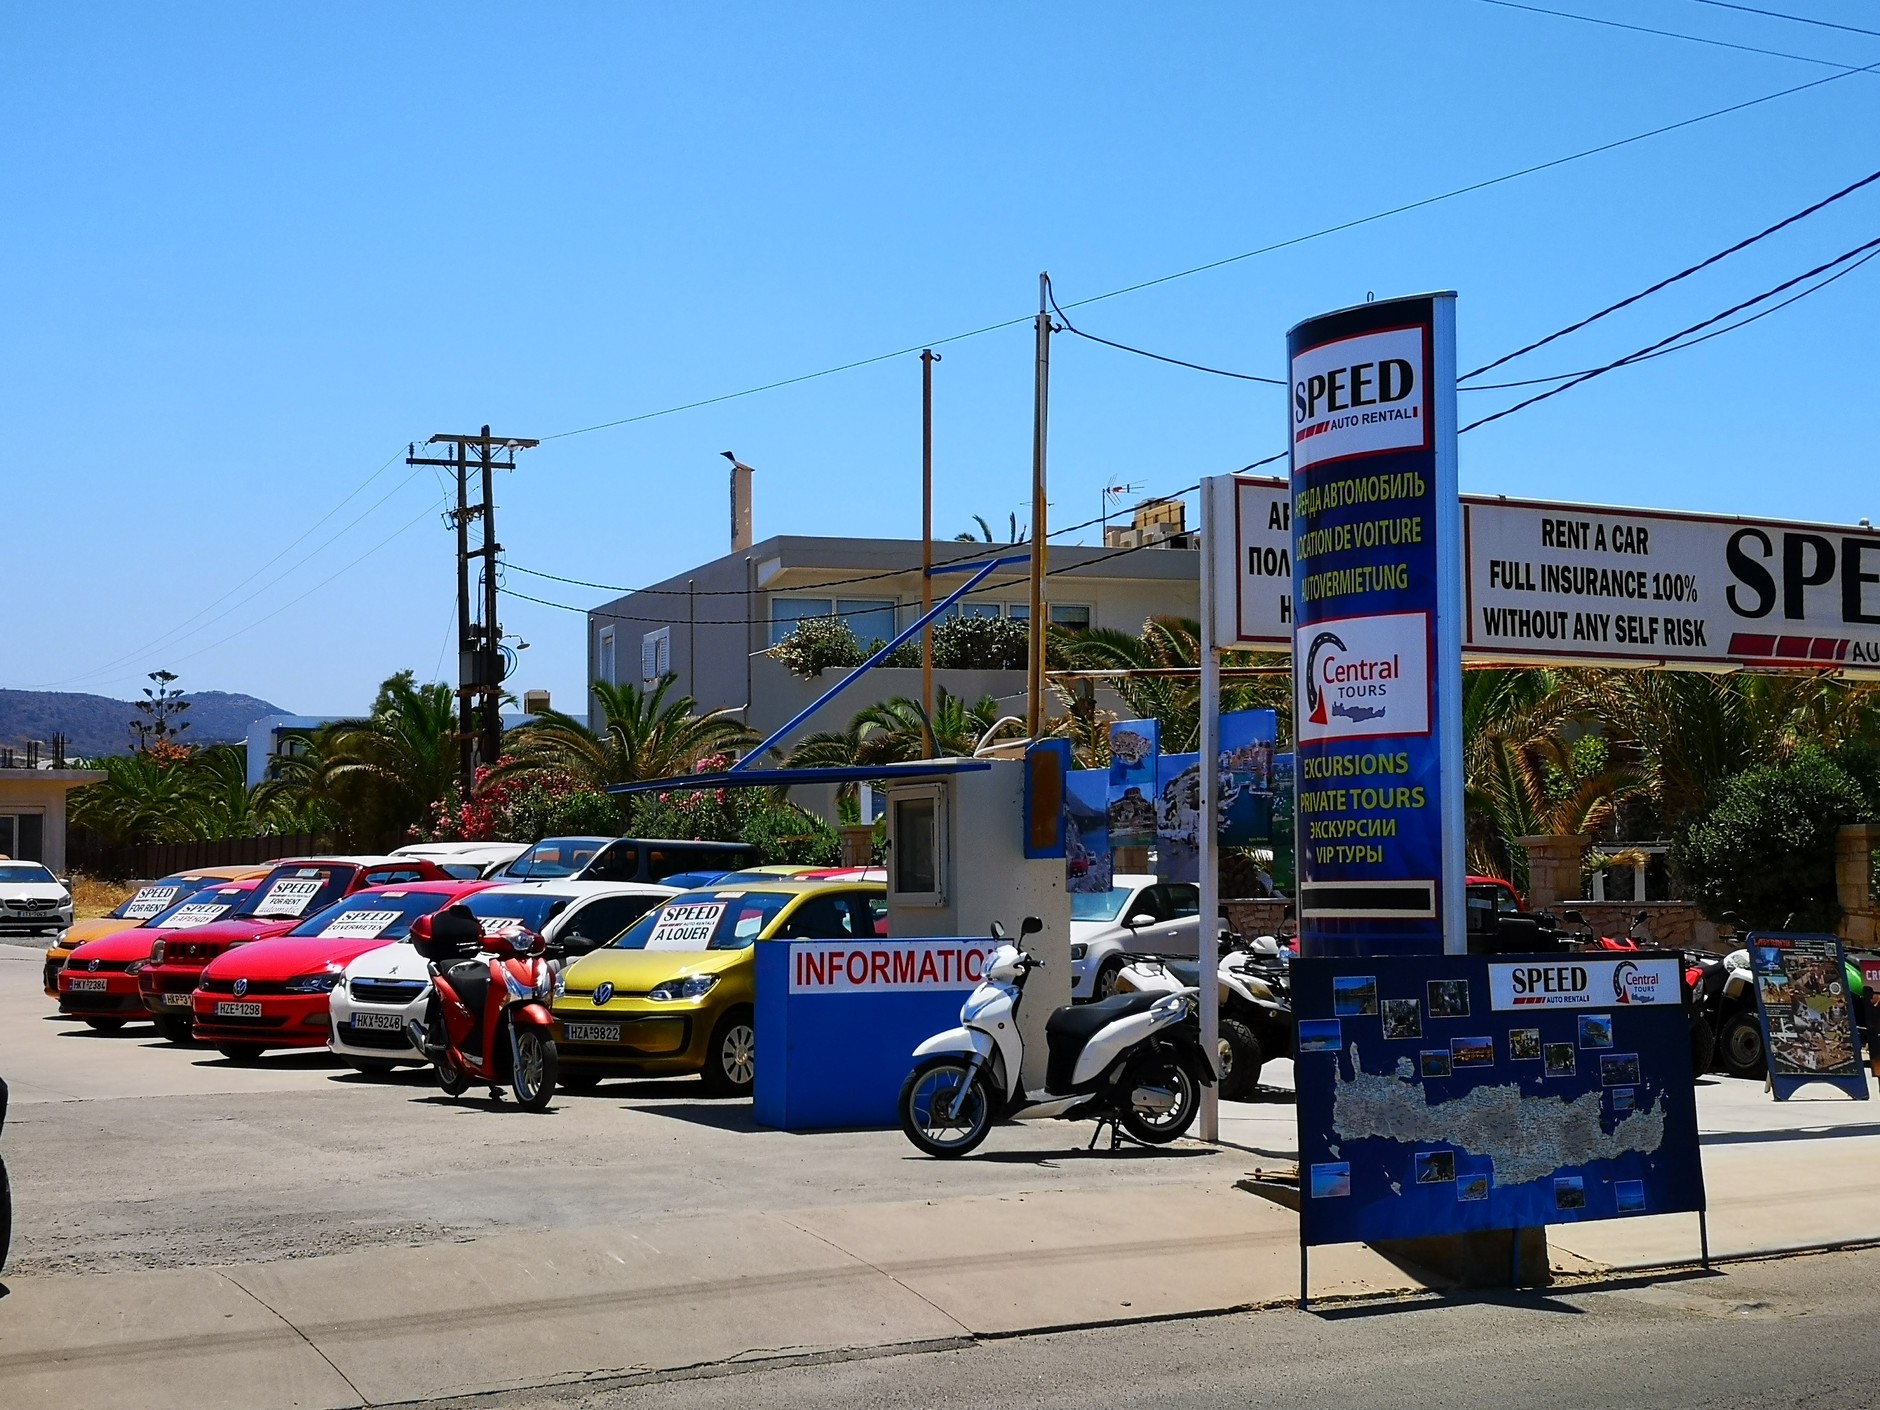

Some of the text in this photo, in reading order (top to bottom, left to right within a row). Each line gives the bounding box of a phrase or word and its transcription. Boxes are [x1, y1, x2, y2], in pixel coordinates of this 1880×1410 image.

[1295, 358, 1414, 424] SPEED
[1330, 407, 1411, 431] AUTO RENTAL
[1323, 471, 1425, 509] АВТОМОБИЛЬ
[1296, 516, 1422, 562] LOCATION DE VOITURE
[1542, 518, 1649, 556] RENT A CAR
[1301, 563, 1408, 603] AUTOVERMIETUNG
[1489, 559, 1698, 603] FULL INSURANCE 100%
[1483, 606, 1707, 648] WITHOUT ANY SELF RISK
[1323, 654, 1399, 684] Central
[1338, 683, 1387, 698] TOURS
[1304, 752, 1409, 779] EXCURSIONS
[1300, 787, 1425, 814] PRIVATE TOURS
[1310, 818, 1396, 840] ЭКСКУРСИИ
[1316, 845, 1383, 864] VIP ТУРЫ
[138, 888, 174, 899] SPEED
[273, 882, 317, 894] SPEED
[128, 903, 166, 913] FOR RENT
[182, 904, 224, 913] SPEED
[258, 906, 300, 914] automatic
[342, 911, 394, 921] SPEED
[663, 905, 720, 921] SPEED
[654, 927, 709, 941] A LOUER
[796, 948, 992, 986] INFORMATIO
[1512, 966, 1588, 994] SPEED
[1625, 972, 1659, 986] Central
[1546, 996, 1563, 1004] AUTO
